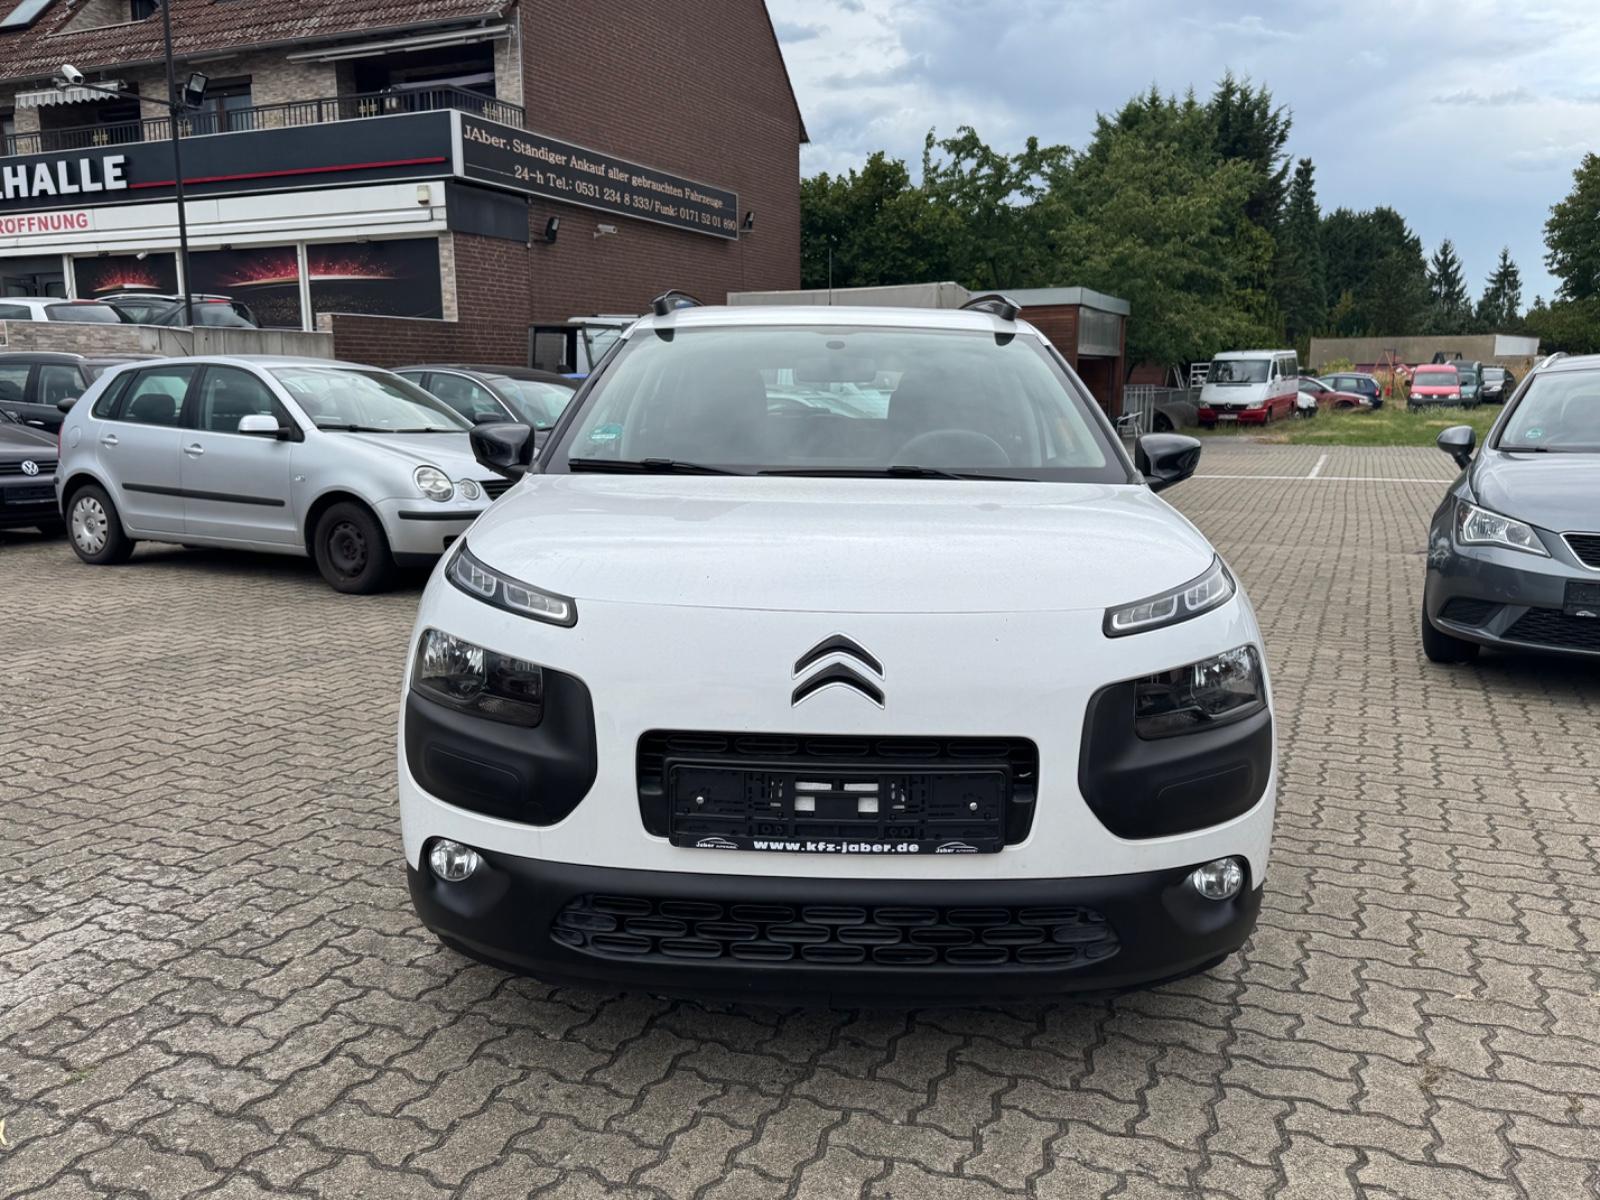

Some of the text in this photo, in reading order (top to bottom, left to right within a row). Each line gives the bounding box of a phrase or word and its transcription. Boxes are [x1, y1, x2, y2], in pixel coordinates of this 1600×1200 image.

[0, 155, 128, 199] HALLE
[513, 139, 566, 165] Ständiger
[569, 155, 606, 177] Ankauf
[608, 168, 630, 182] aller
[632, 175, 683, 197] gebrauchten
[685, 188, 723, 208] Fahrzeuge
[514, 164, 544, 185] 24-h
[545, 172, 573, 190] Tel.:
[575, 180, 600, 198] 0531
[603, 187, 621, 204] 234
[623, 193, 631, 206] 8
[679, 207, 699, 223] 0171
[700, 212, 711, 225] 52
[711, 215, 721, 228] 01
[753, 840, 920, 854] www.kfz-jaber.de
